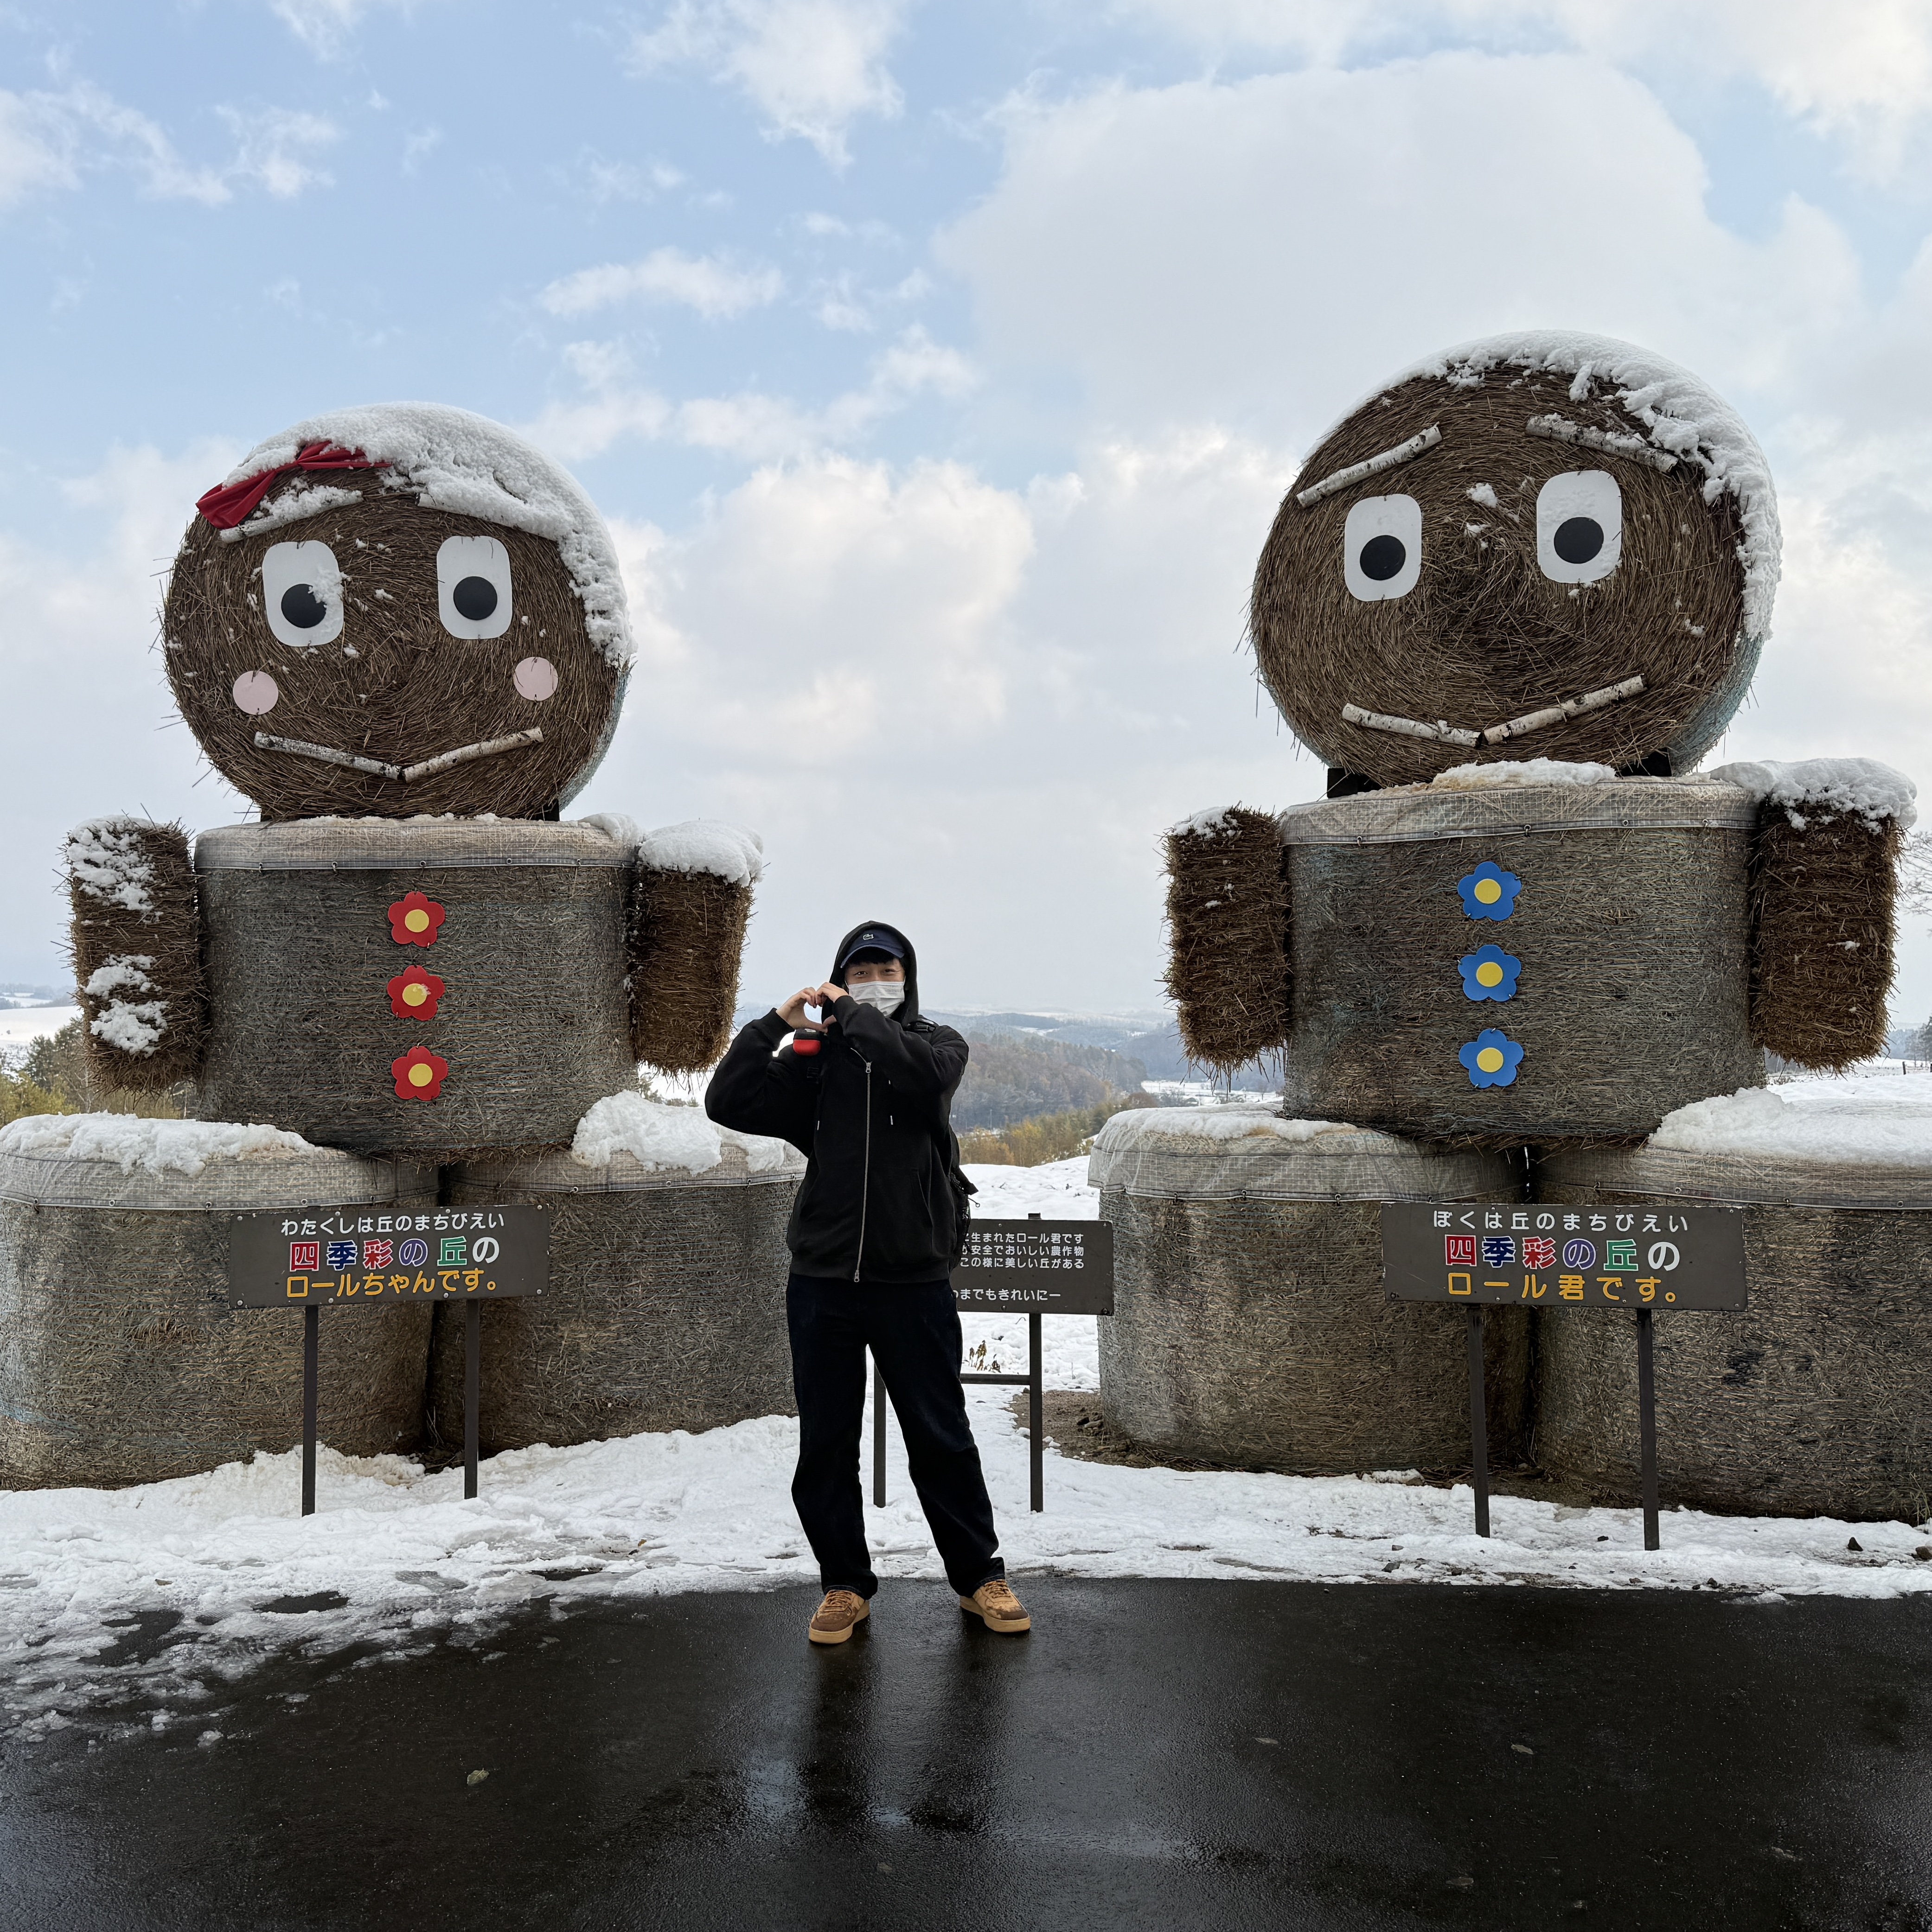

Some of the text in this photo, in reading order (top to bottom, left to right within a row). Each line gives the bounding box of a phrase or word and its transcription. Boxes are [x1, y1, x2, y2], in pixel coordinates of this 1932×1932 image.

[281, 1213, 505, 1236] わたくしは丘のまちびえい
[1433, 1211, 1688, 1231] ぼくは丘のまちびえい
[289, 1235, 499, 1272] 四季彩の丘の
[960, 1257, 1084, 1269] この様に美しい丘がある
[1445, 1234, 1680, 1271] 四季彩の丘の
[287, 1268, 496, 1297] ロールちゃんです。
[1447, 1272, 1676, 1302] ロール君です。
